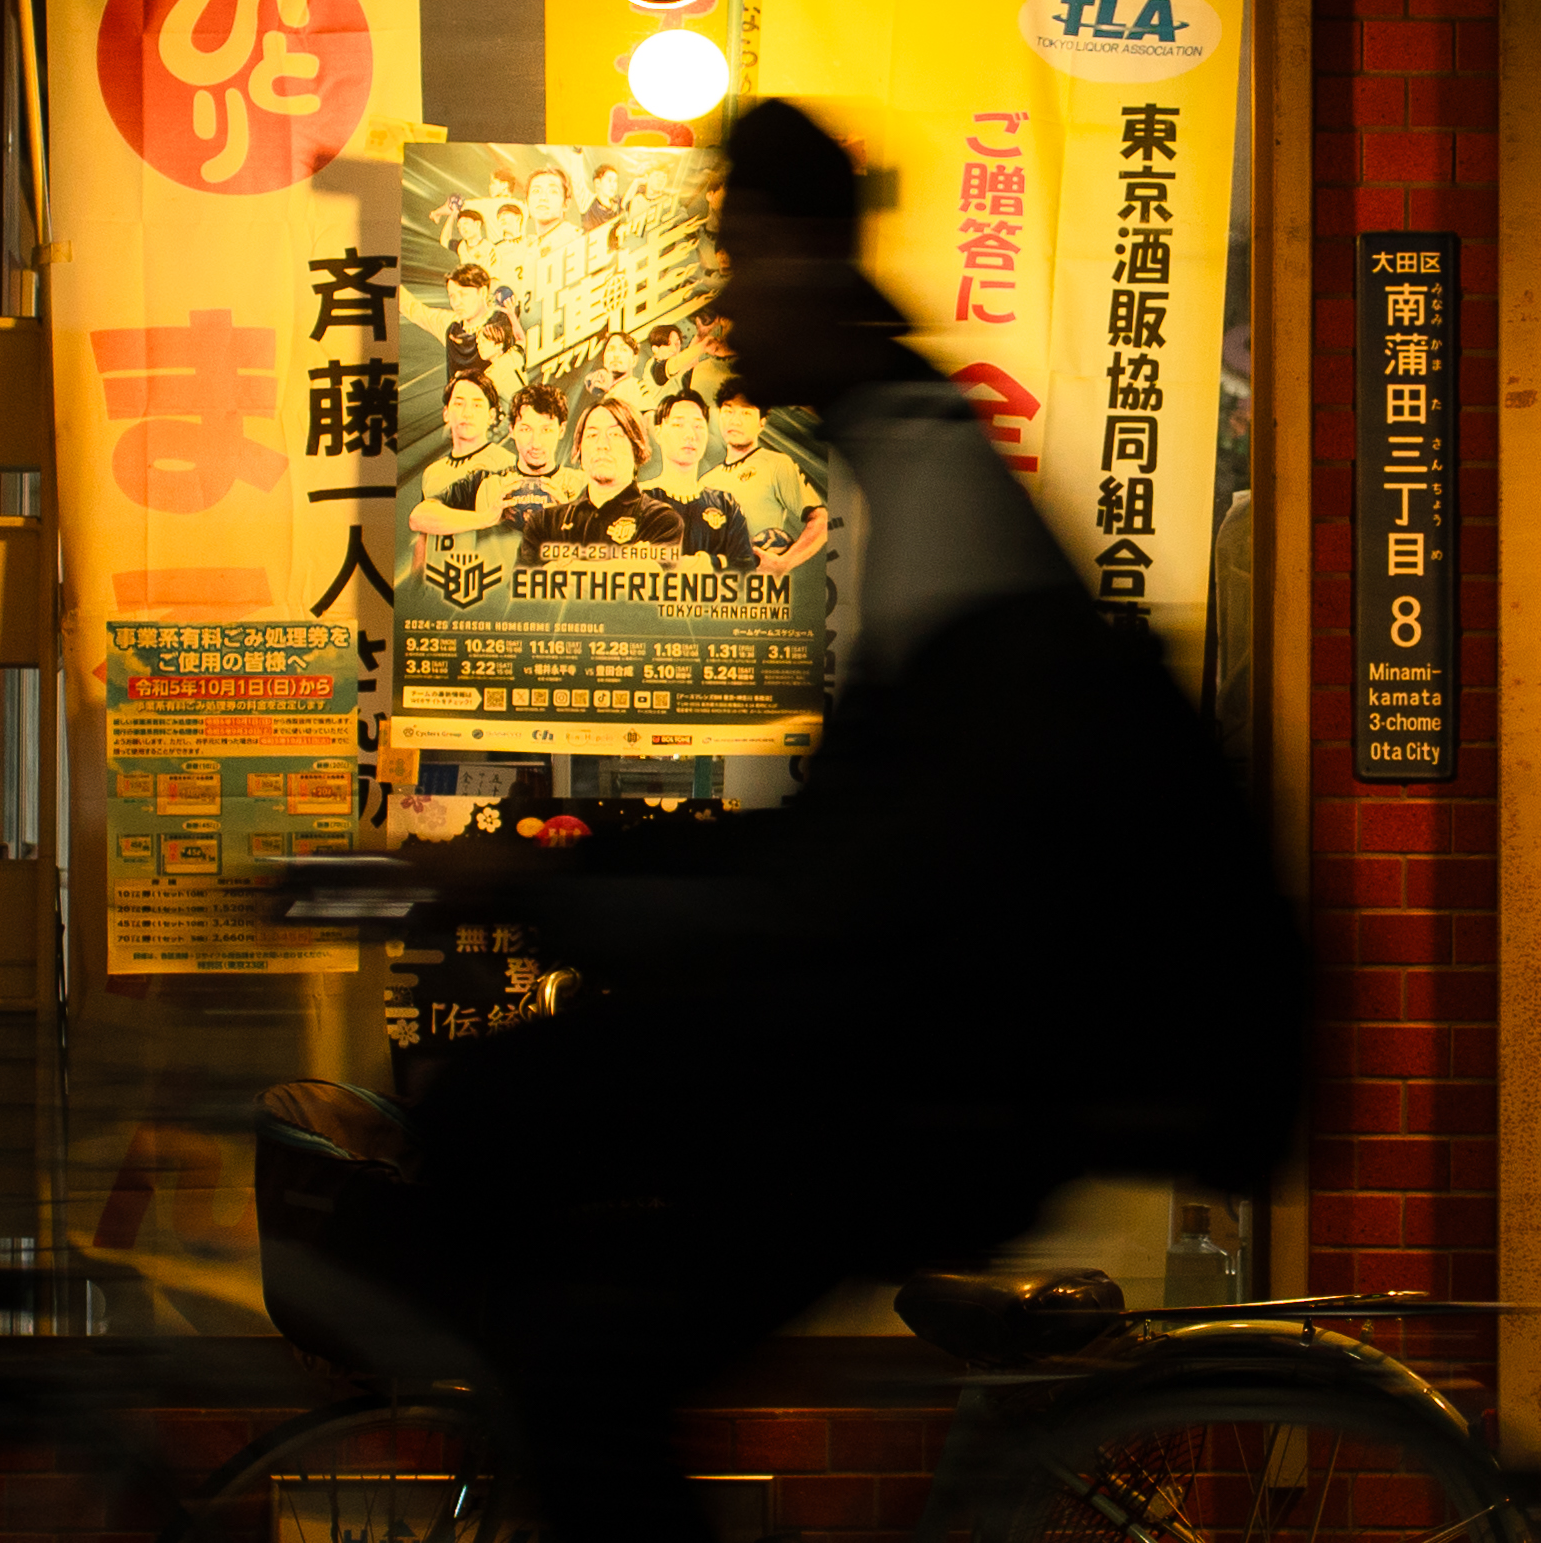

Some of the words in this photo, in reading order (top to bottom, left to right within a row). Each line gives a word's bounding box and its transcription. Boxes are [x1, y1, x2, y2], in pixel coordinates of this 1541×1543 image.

[1036, 36, 1073, 50] TOKYO
[1075, 41, 1119, 53] LIQUOR
[1122, 44, 1202, 56] ASSOCIATION
[956, 112, 1029, 323] ご贈答に
[1372, 252, 1441, 273] 大田区
[1384, 283, 1428, 577] 南蒲田三丁目
[512, 570, 738, 603] EARTHFRIENDS
[747, 574, 790, 604] BM
[658, 604, 790, 620] TOKYO-KANAGAWA
[1390, 596, 1421, 647] 8
[406, 639, 440, 652] 9.23
[465, 639, 505, 653] 10.26
[530, 641, 564, 654] 11.16
[589, 642, 629, 656] 12.28
[654, 642, 682, 656] 1.18
[708, 644, 737, 658] 1.31
[159, 652, 307, 672] ご使用の皆様へ
[406, 660, 431, 674] 3.8
[461, 661, 495, 675] 3.22
[644, 664, 674, 679] 5.10
[704, 666, 737, 680] 5.24
[1369, 663, 1441, 681] Minami-
[1369, 688, 1442, 707] kamata
[1369, 713, 1441, 732] 3-chome
[1371, 743, 1403, 761] Ota
[1407, 743, 1440, 764] City
